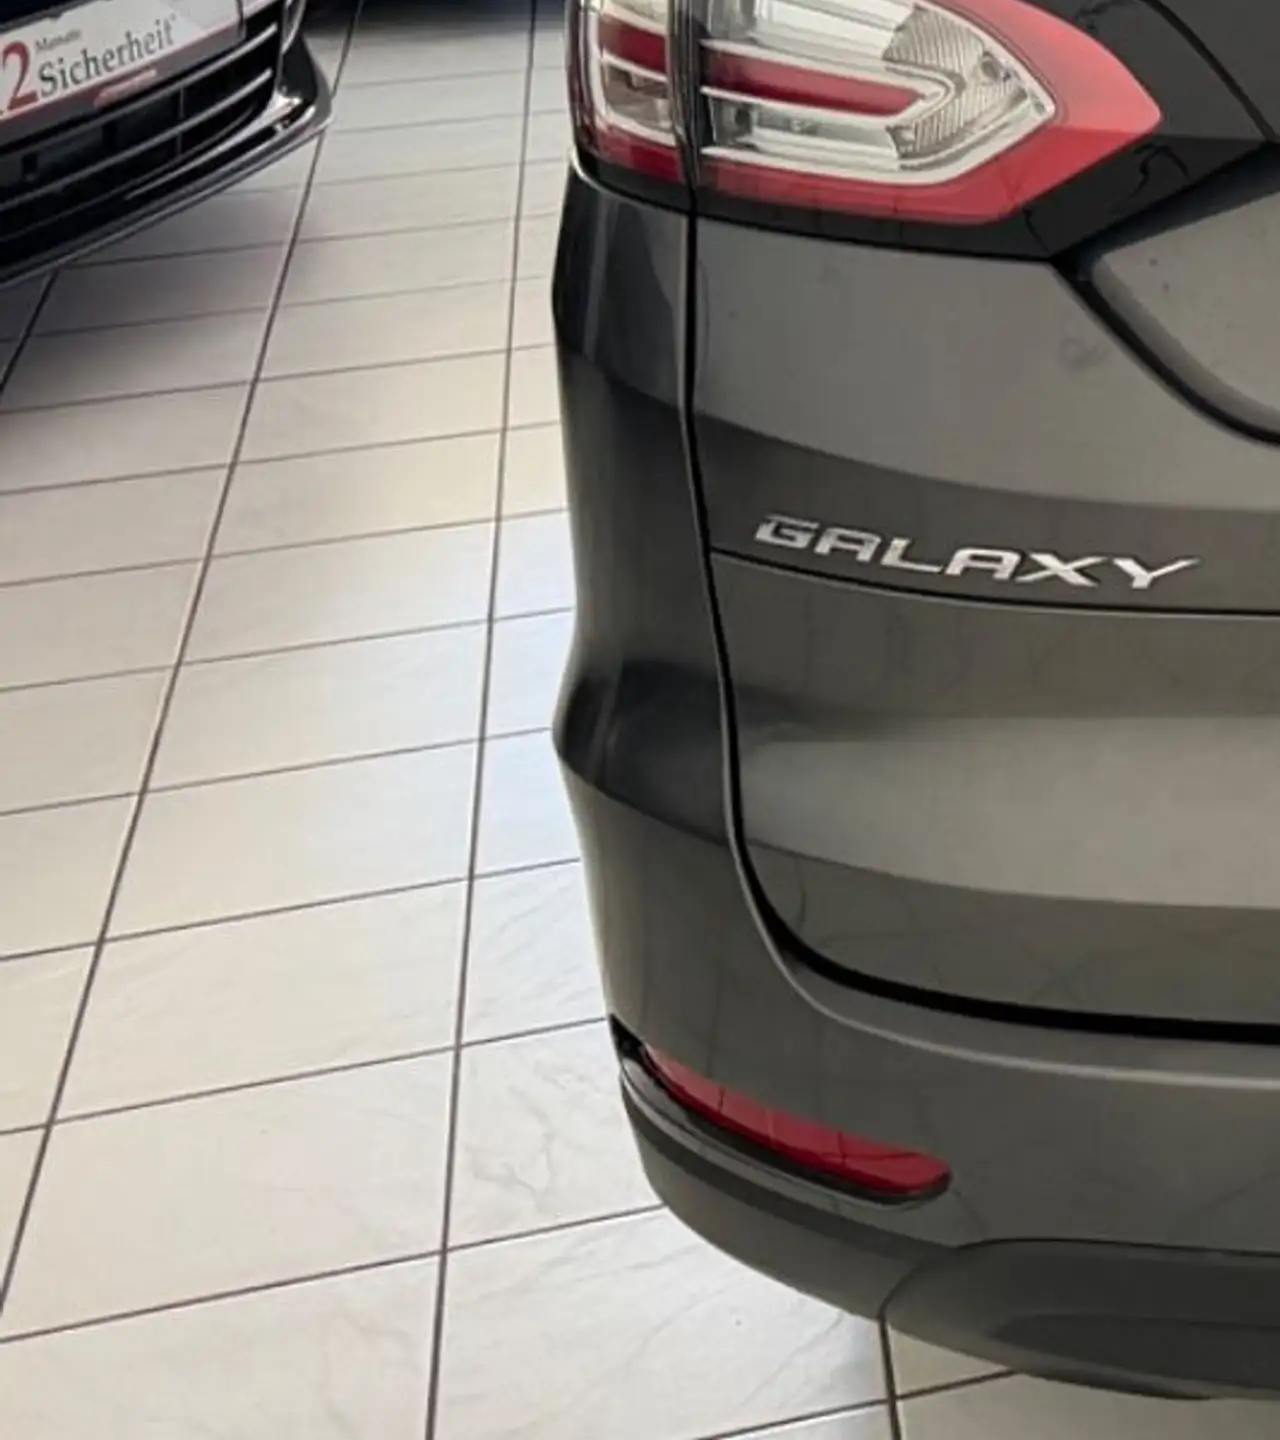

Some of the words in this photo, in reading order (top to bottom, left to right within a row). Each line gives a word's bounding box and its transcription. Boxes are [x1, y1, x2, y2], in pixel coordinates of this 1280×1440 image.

[0, 40, 38, 114] 2
[38, 16, 173, 97] Sicherheit
[754, 513, 1199, 589] GALAXY
